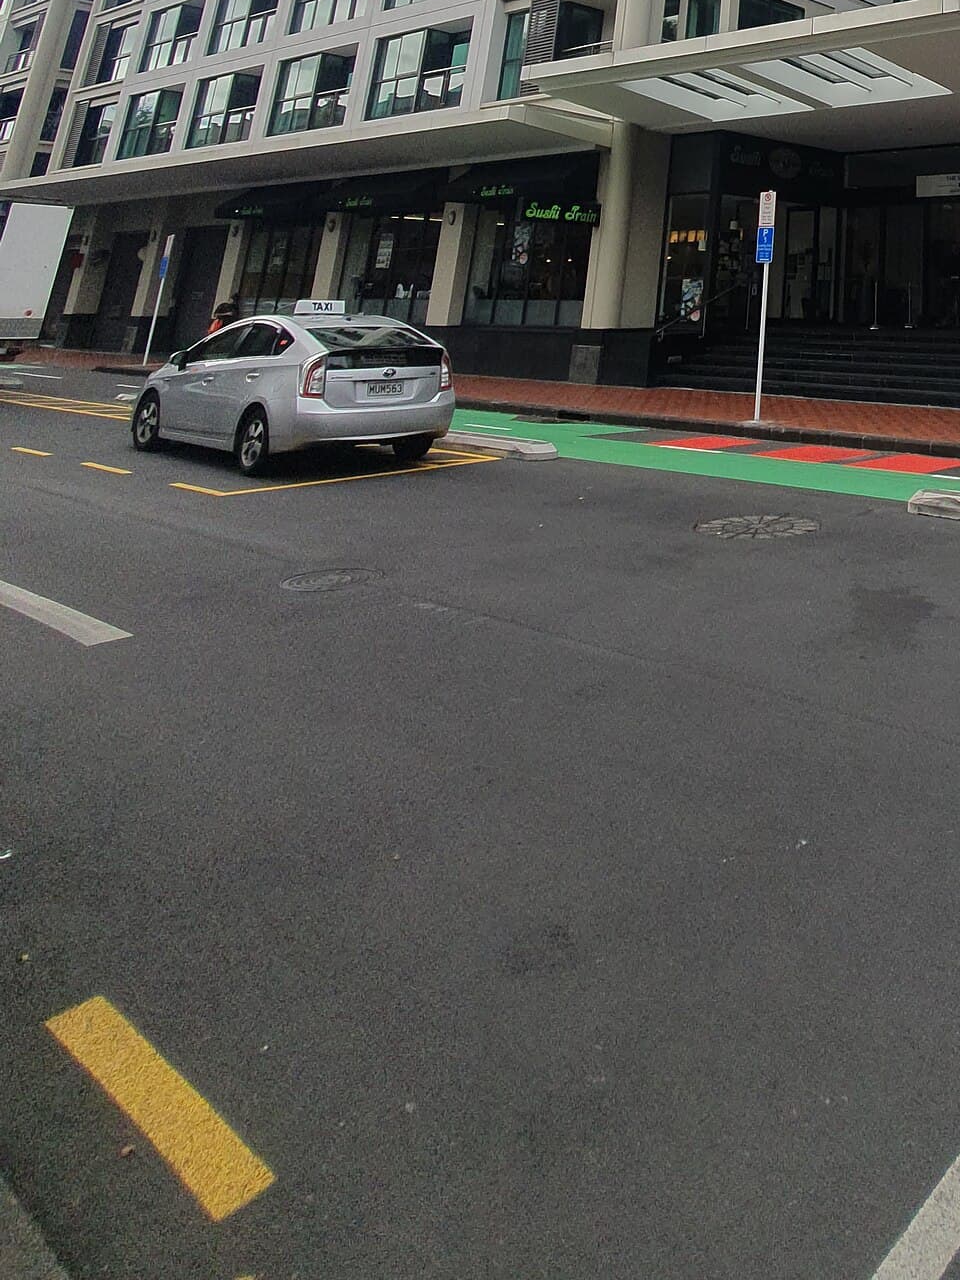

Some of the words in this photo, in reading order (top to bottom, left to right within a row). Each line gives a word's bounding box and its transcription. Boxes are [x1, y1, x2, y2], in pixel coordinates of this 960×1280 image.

[525, 202, 562, 220] Sushi
[565, 205, 598, 223] Train
[311, 302, 333, 311] TAXI
